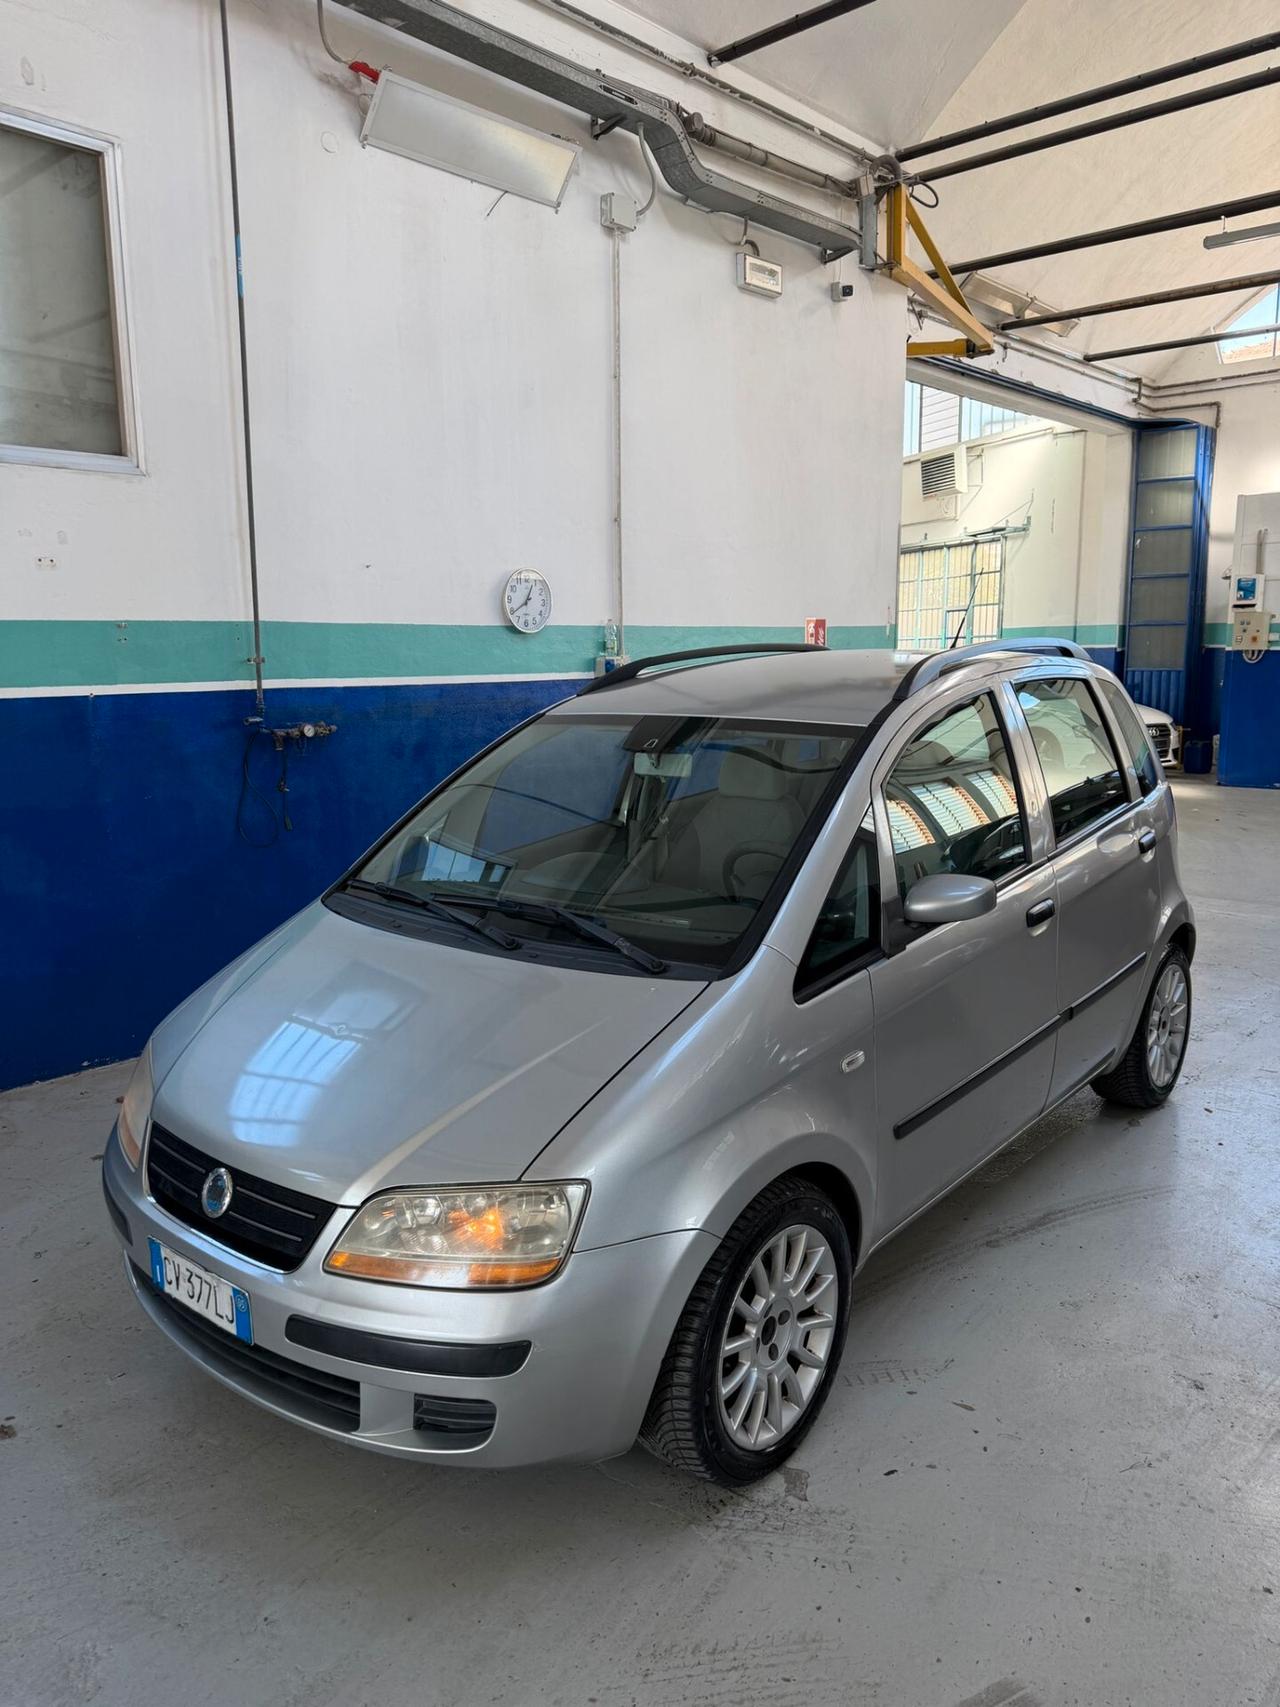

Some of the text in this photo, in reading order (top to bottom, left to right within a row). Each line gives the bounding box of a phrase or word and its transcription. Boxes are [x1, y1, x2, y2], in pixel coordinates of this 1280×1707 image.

[538, 588, 543, 596] 2
[507, 595, 512, 604] 9
[541, 599, 545, 607] 3
[516, 615, 520, 623] 7
[524, 619, 528, 627] 6
[532, 617, 537, 625] 5
[164, 1257, 180, 1290] CV
